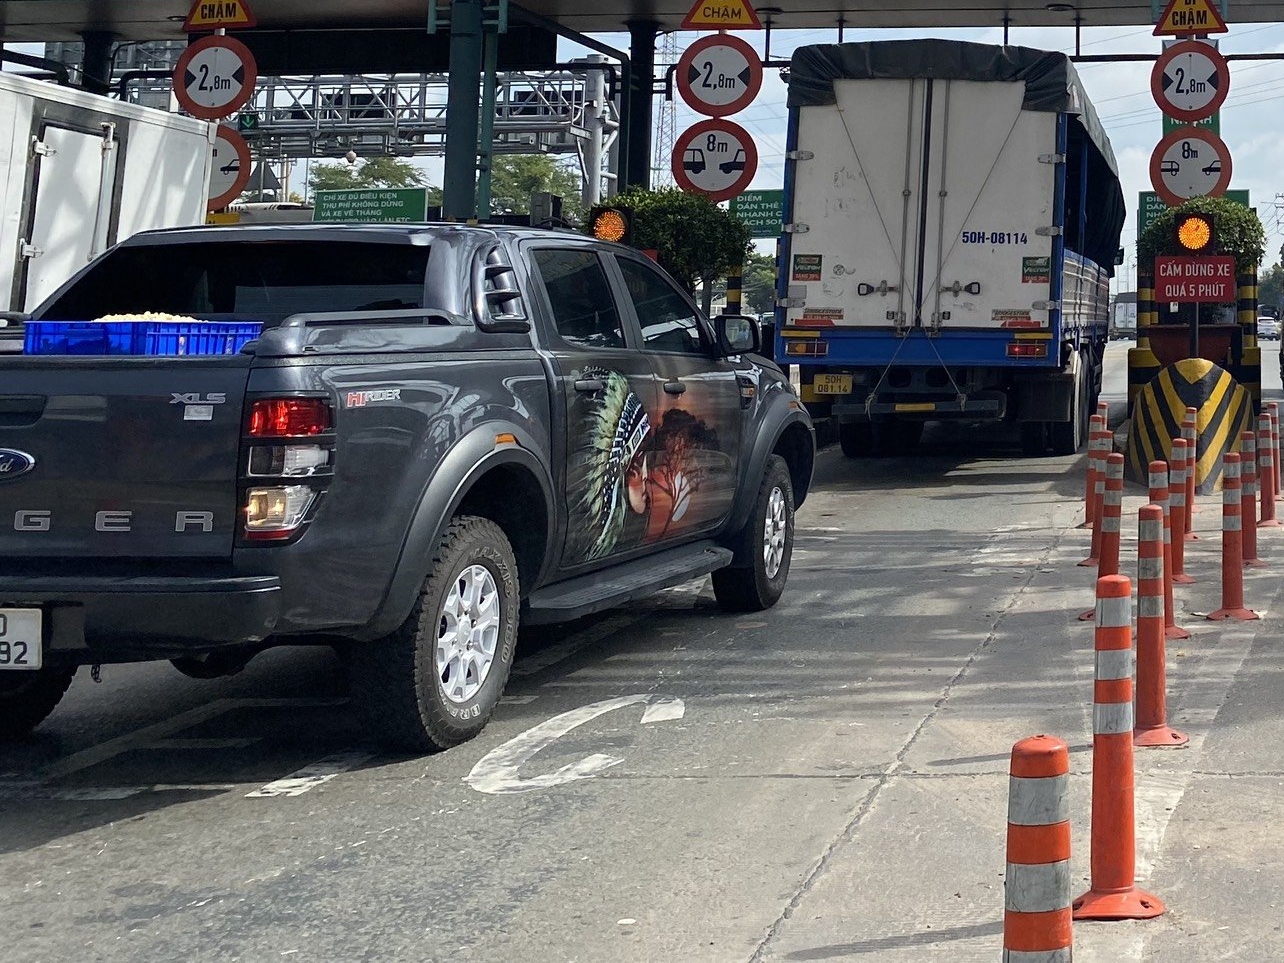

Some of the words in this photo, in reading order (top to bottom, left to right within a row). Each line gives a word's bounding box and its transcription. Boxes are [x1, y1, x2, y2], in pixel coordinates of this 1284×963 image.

[198, 64, 231, 93] 2,8m
[702, 61, 736, 91] 2,8m
[1175, 67, 1206, 96] 2,8m
[706, 134, 728, 153] 8m
[1182, 141, 1199, 159] 8m
[961, 231, 1029, 245] 50H-08114
[1160, 259, 1182, 277] CẤM
[1186, 261, 1214, 277] DỪNG
[1217, 263, 1230, 277] XE
[1165, 282, 1186, 297] QUÁ
[1189, 284, 1196, 297] 5
[1199, 282, 1226, 297] PHÚT
[817, 384, 848, 392] 081.14
[825, 375, 842, 384] 50H
[169, 393, 227, 404] XLS
